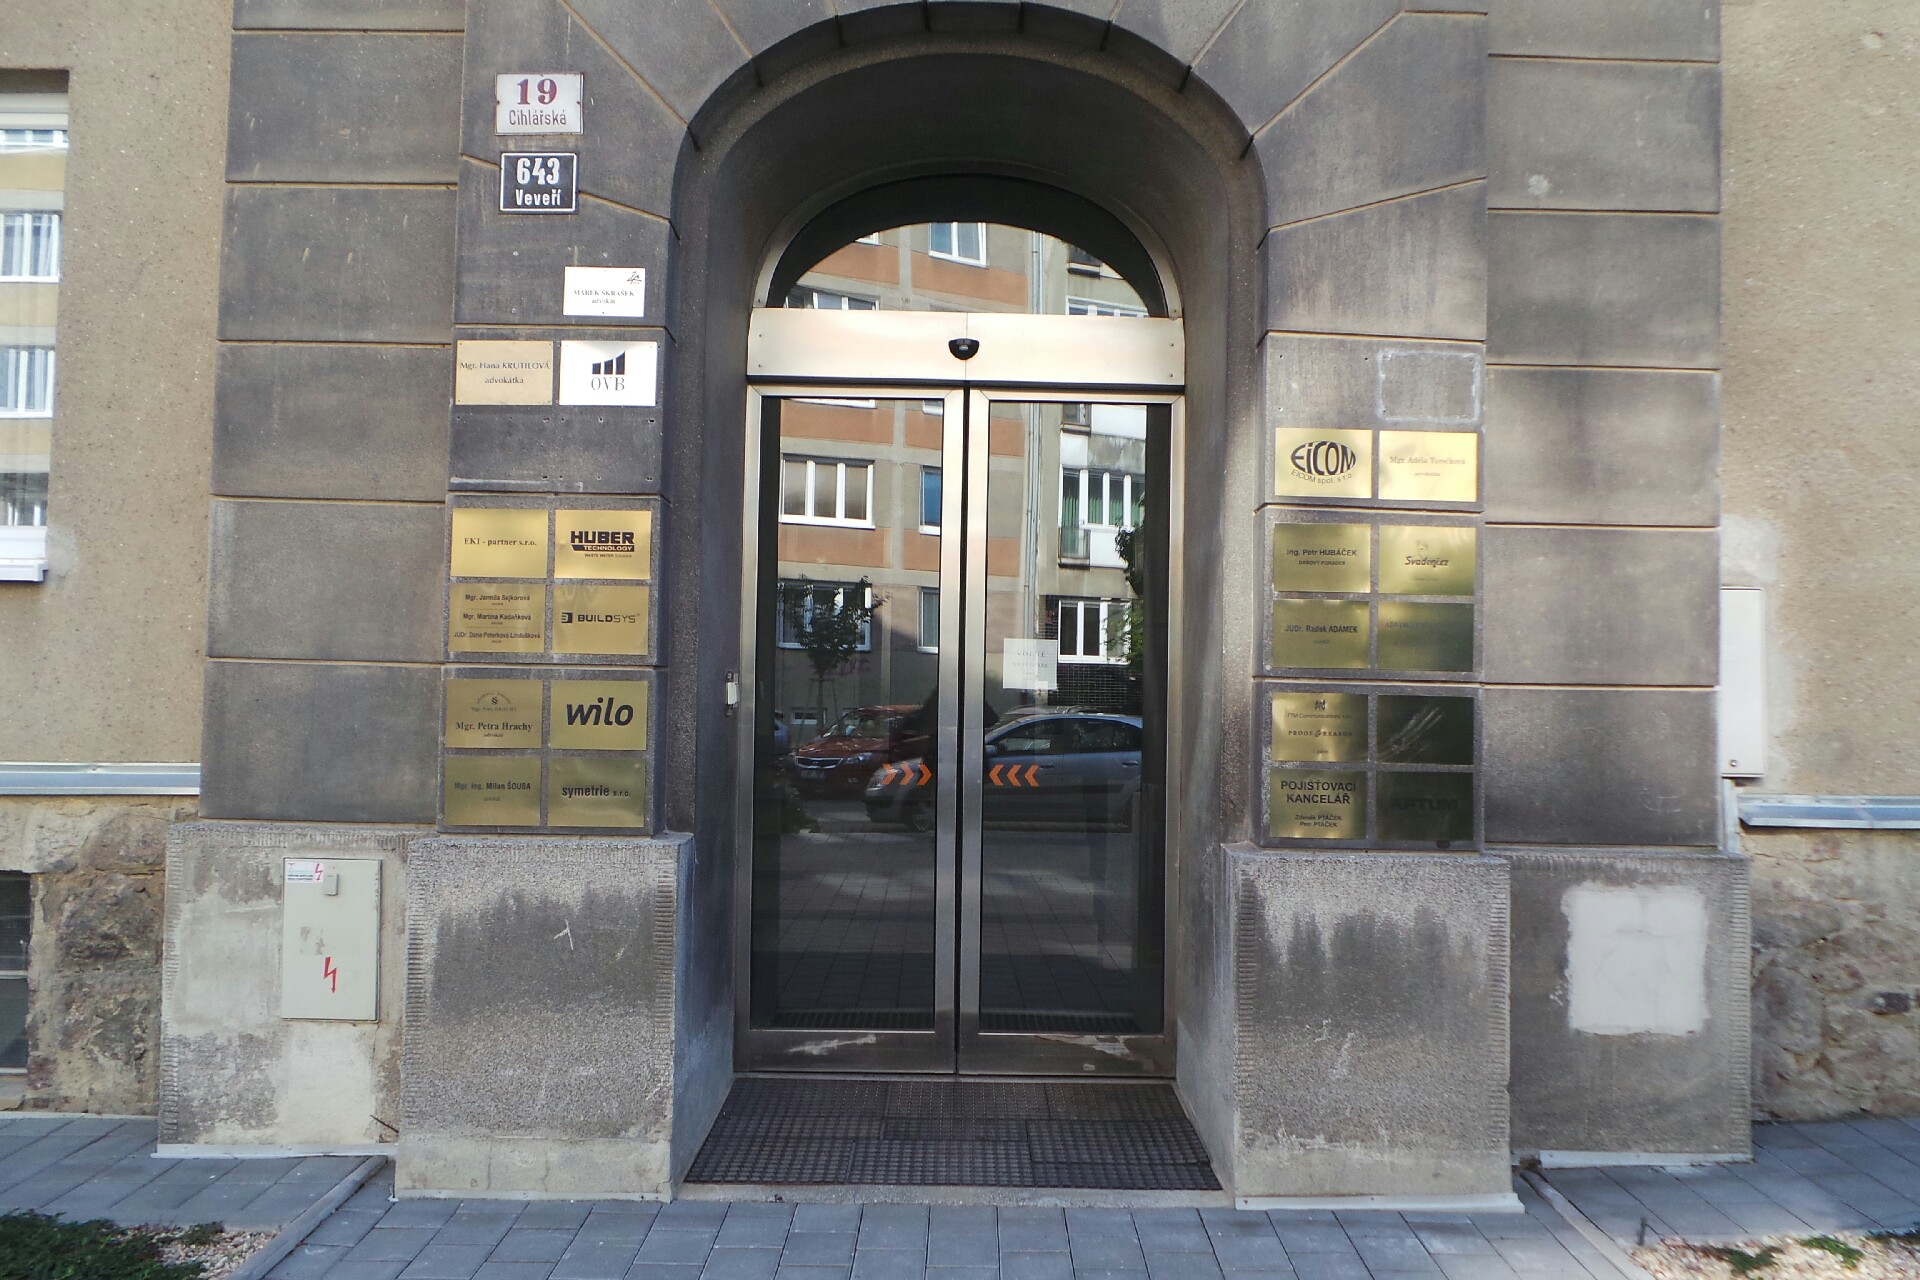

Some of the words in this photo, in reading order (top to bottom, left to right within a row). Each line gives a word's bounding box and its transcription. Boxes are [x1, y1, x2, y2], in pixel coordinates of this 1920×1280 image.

[517, 78, 557, 105] 19
[509, 110, 567, 126] Cihlářská
[516, 157, 560, 185] 643
[516, 189, 561, 206] Veveří
[459, 362, 477, 371] Mgr.
[484, 376, 525, 384] advokátka
[591, 377, 626, 391] OVB
[464, 537, 480, 545] EKI
[487, 539, 518, 547] partner
[570, 530, 635, 544] HUBER
[1286, 549, 1300, 557] Ing.
[1319, 548, 1358, 557] HUBÁČEK
[465, 594, 478, 602] Mgr.
[463, 613, 476, 621] Mgr.
[577, 614, 636, 623] BUILDSYS
[1306, 625, 1327, 633] Radek
[566, 697, 634, 726] wilo
[456, 722, 475, 731] Mgr.
[478, 722, 500, 730] Petra
[502, 722, 533, 733] Hrachy
[486, 782, 506, 790] Milan
[562, 785, 610, 798] symetrie
[1287, 793, 1351, 804] KANCELÁŘ
